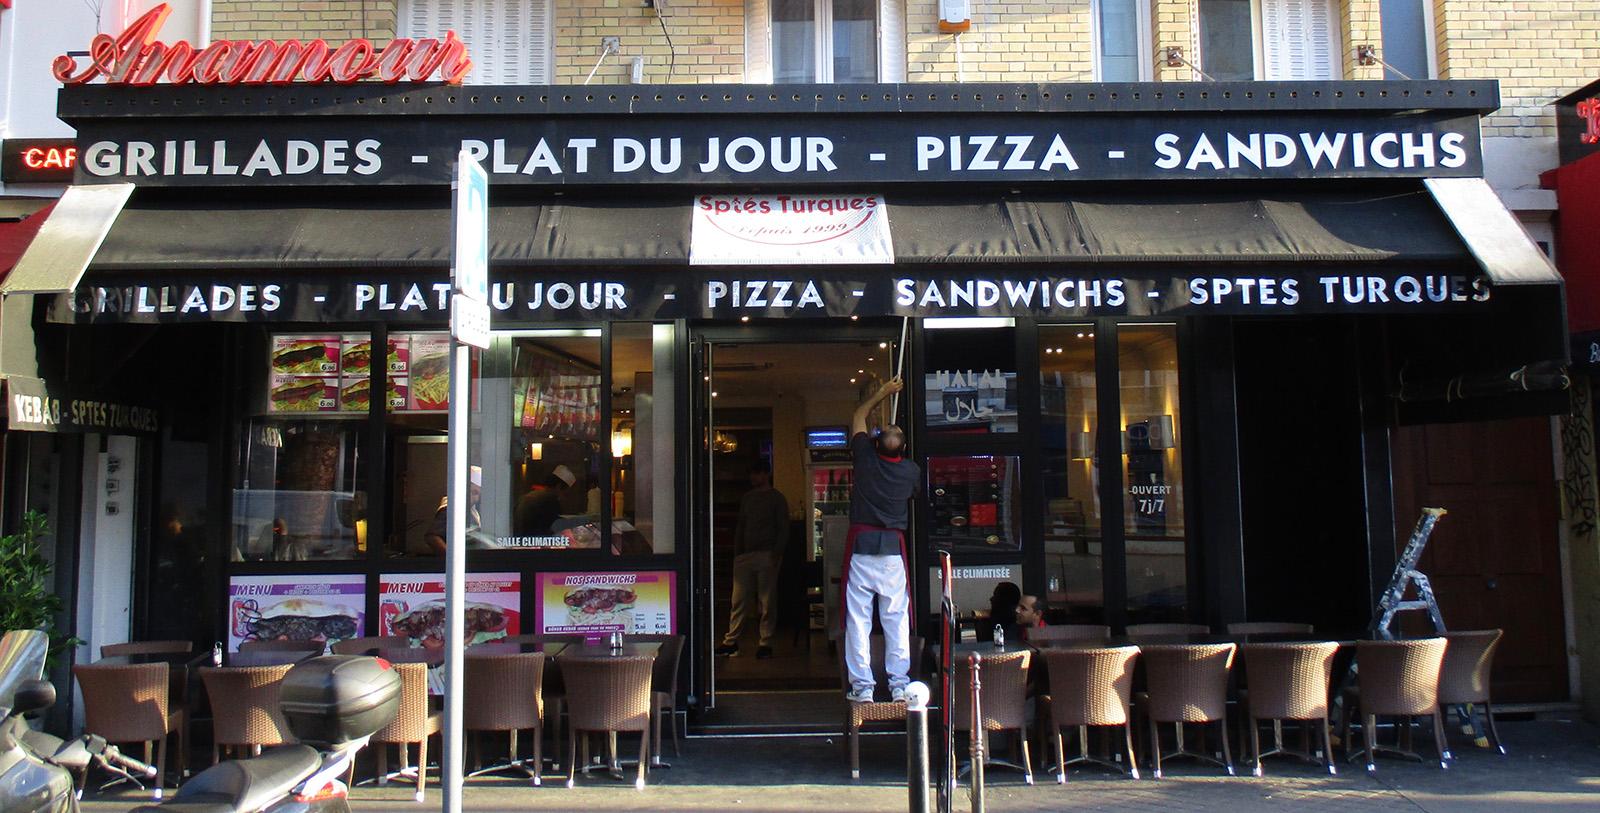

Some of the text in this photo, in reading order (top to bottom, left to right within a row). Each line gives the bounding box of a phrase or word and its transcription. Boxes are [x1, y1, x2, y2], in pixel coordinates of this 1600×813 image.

[52, 2, 472, 87] Anamour
[84, 138, 382, 177] GRILLADES
[461, 136, 597, 176] PLAT
[613, 137, 682, 174] DU
[698, 136, 839, 174] JOUR
[916, 133, 1080, 172] PIZZA
[1154, 131, 1468, 170] SANDWICHS
[777, 194, 878, 215] Turques
[803, 223, 848, 235] 1999
[70, 285, 281, 313] GRILLADES
[356, 282, 451, 312] PLAT
[527, 281, 628, 311] JOUR
[708, 279, 825, 309] PIZZA
[896, 278, 1125, 308] SANDWICHS
[1189, 277, 1300, 307] SPTES
[1319, 275, 1491, 303] TURQUES
[936, 369, 1007, 389] HALAL
[14, 394, 61, 425] KEBAB
[71, 399, 107, 426] SPTES
[1132, 485, 1172, 495] OUVERT
[1139, 499, 1165, 515] 7j/7
[497, 535, 570, 547] SALLE CLIMATISÉE
[565, 573, 637, 586] NOS SANDWICHS
[963, 566, 1011, 579] CLIMATISÉE
[236, 583, 274, 596] MENU
[387, 582, 424, 594] MENU
